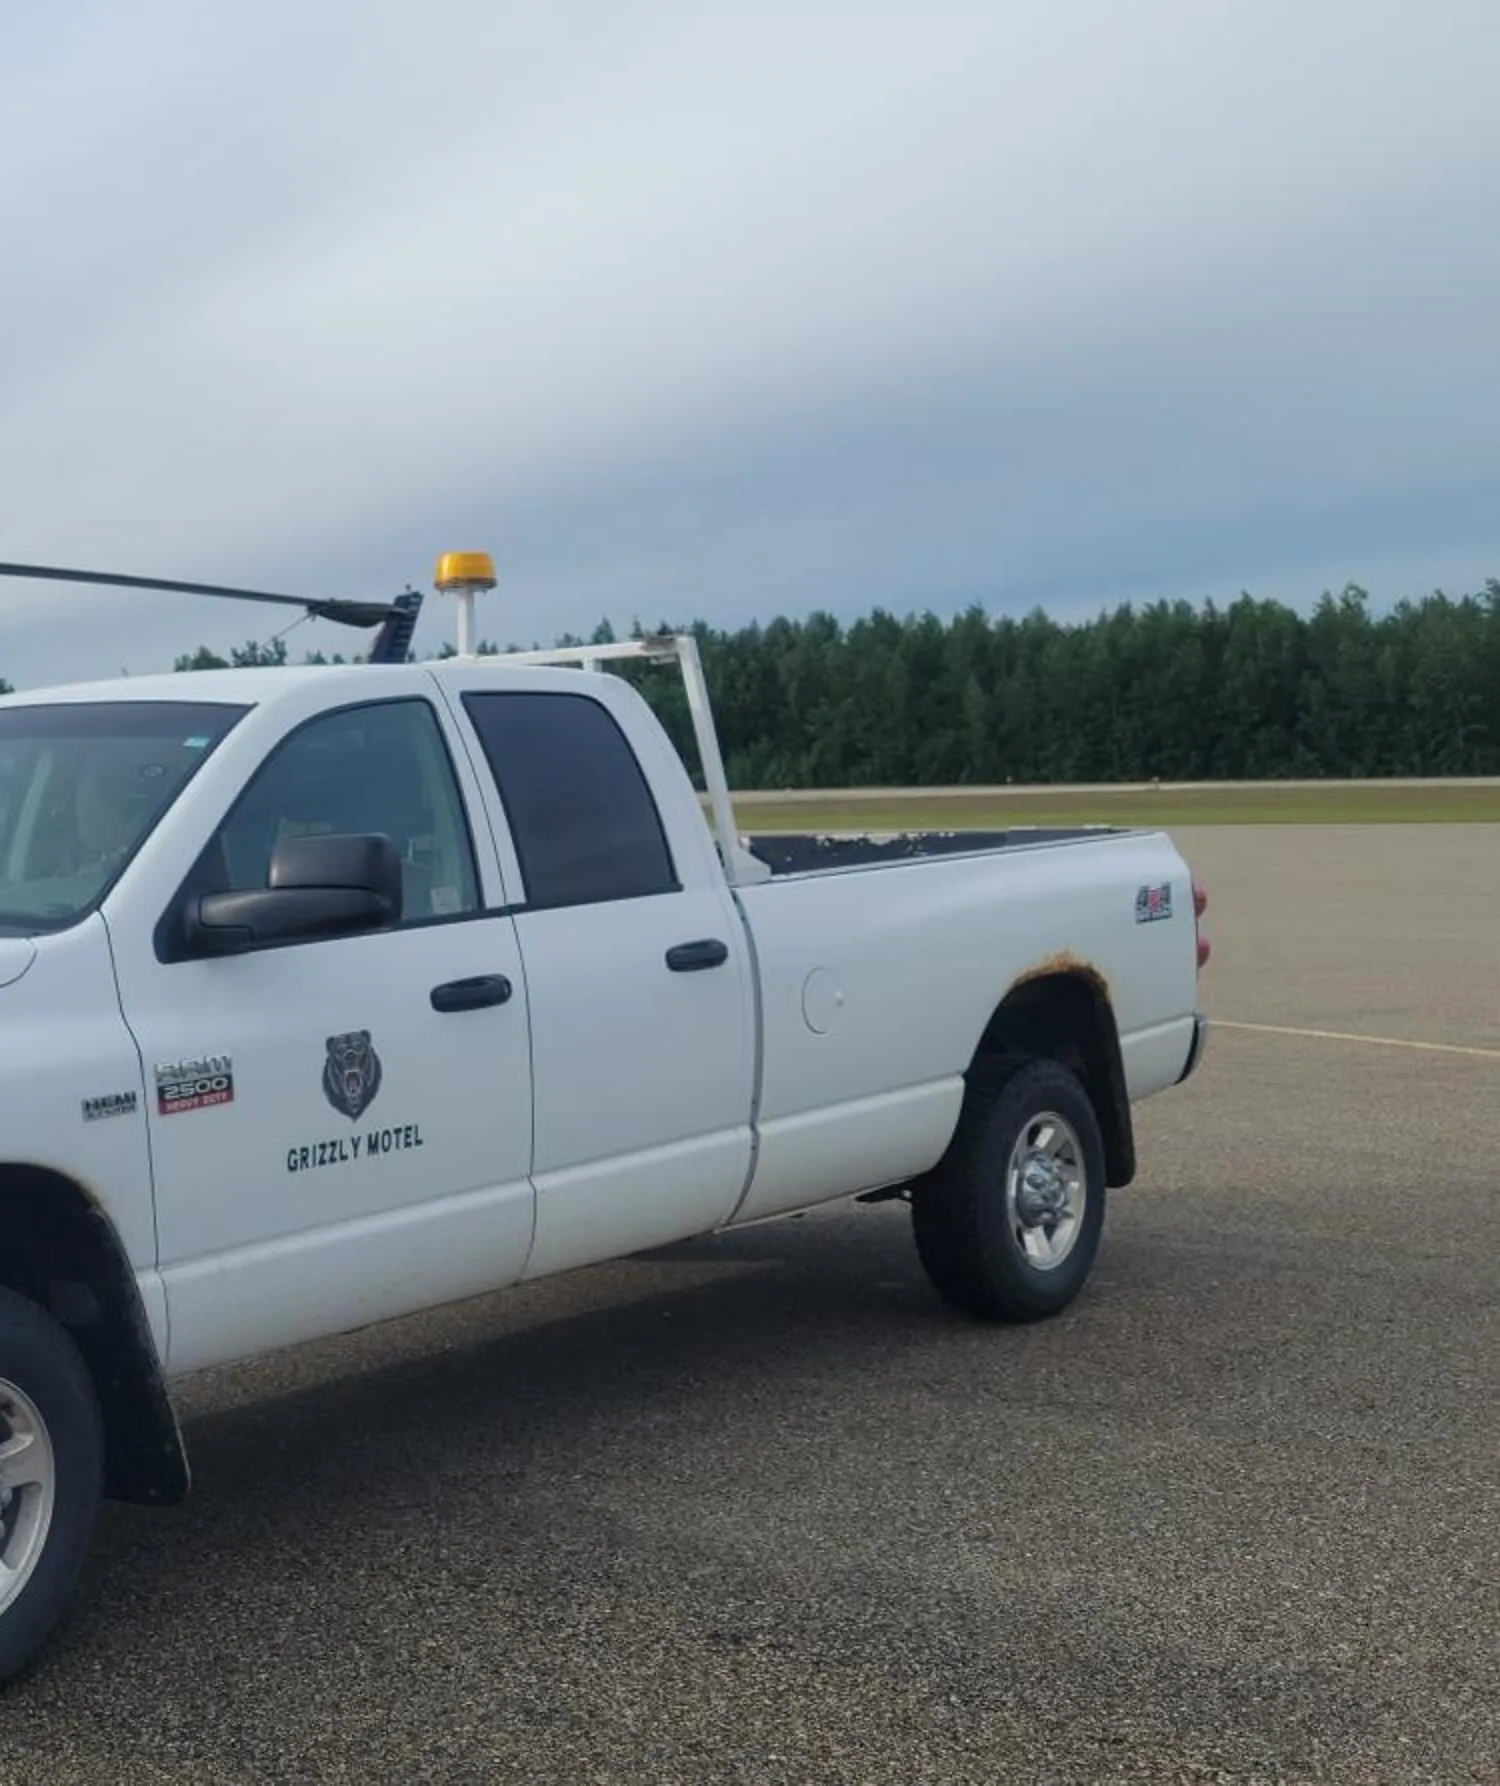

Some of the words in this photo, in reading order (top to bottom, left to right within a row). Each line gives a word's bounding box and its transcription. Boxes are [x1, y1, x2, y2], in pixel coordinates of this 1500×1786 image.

[164, 1077, 229, 1100] 2500
[287, 1135, 361, 1173] GRIZZLY
[367, 1124, 423, 1155] MOTEL
